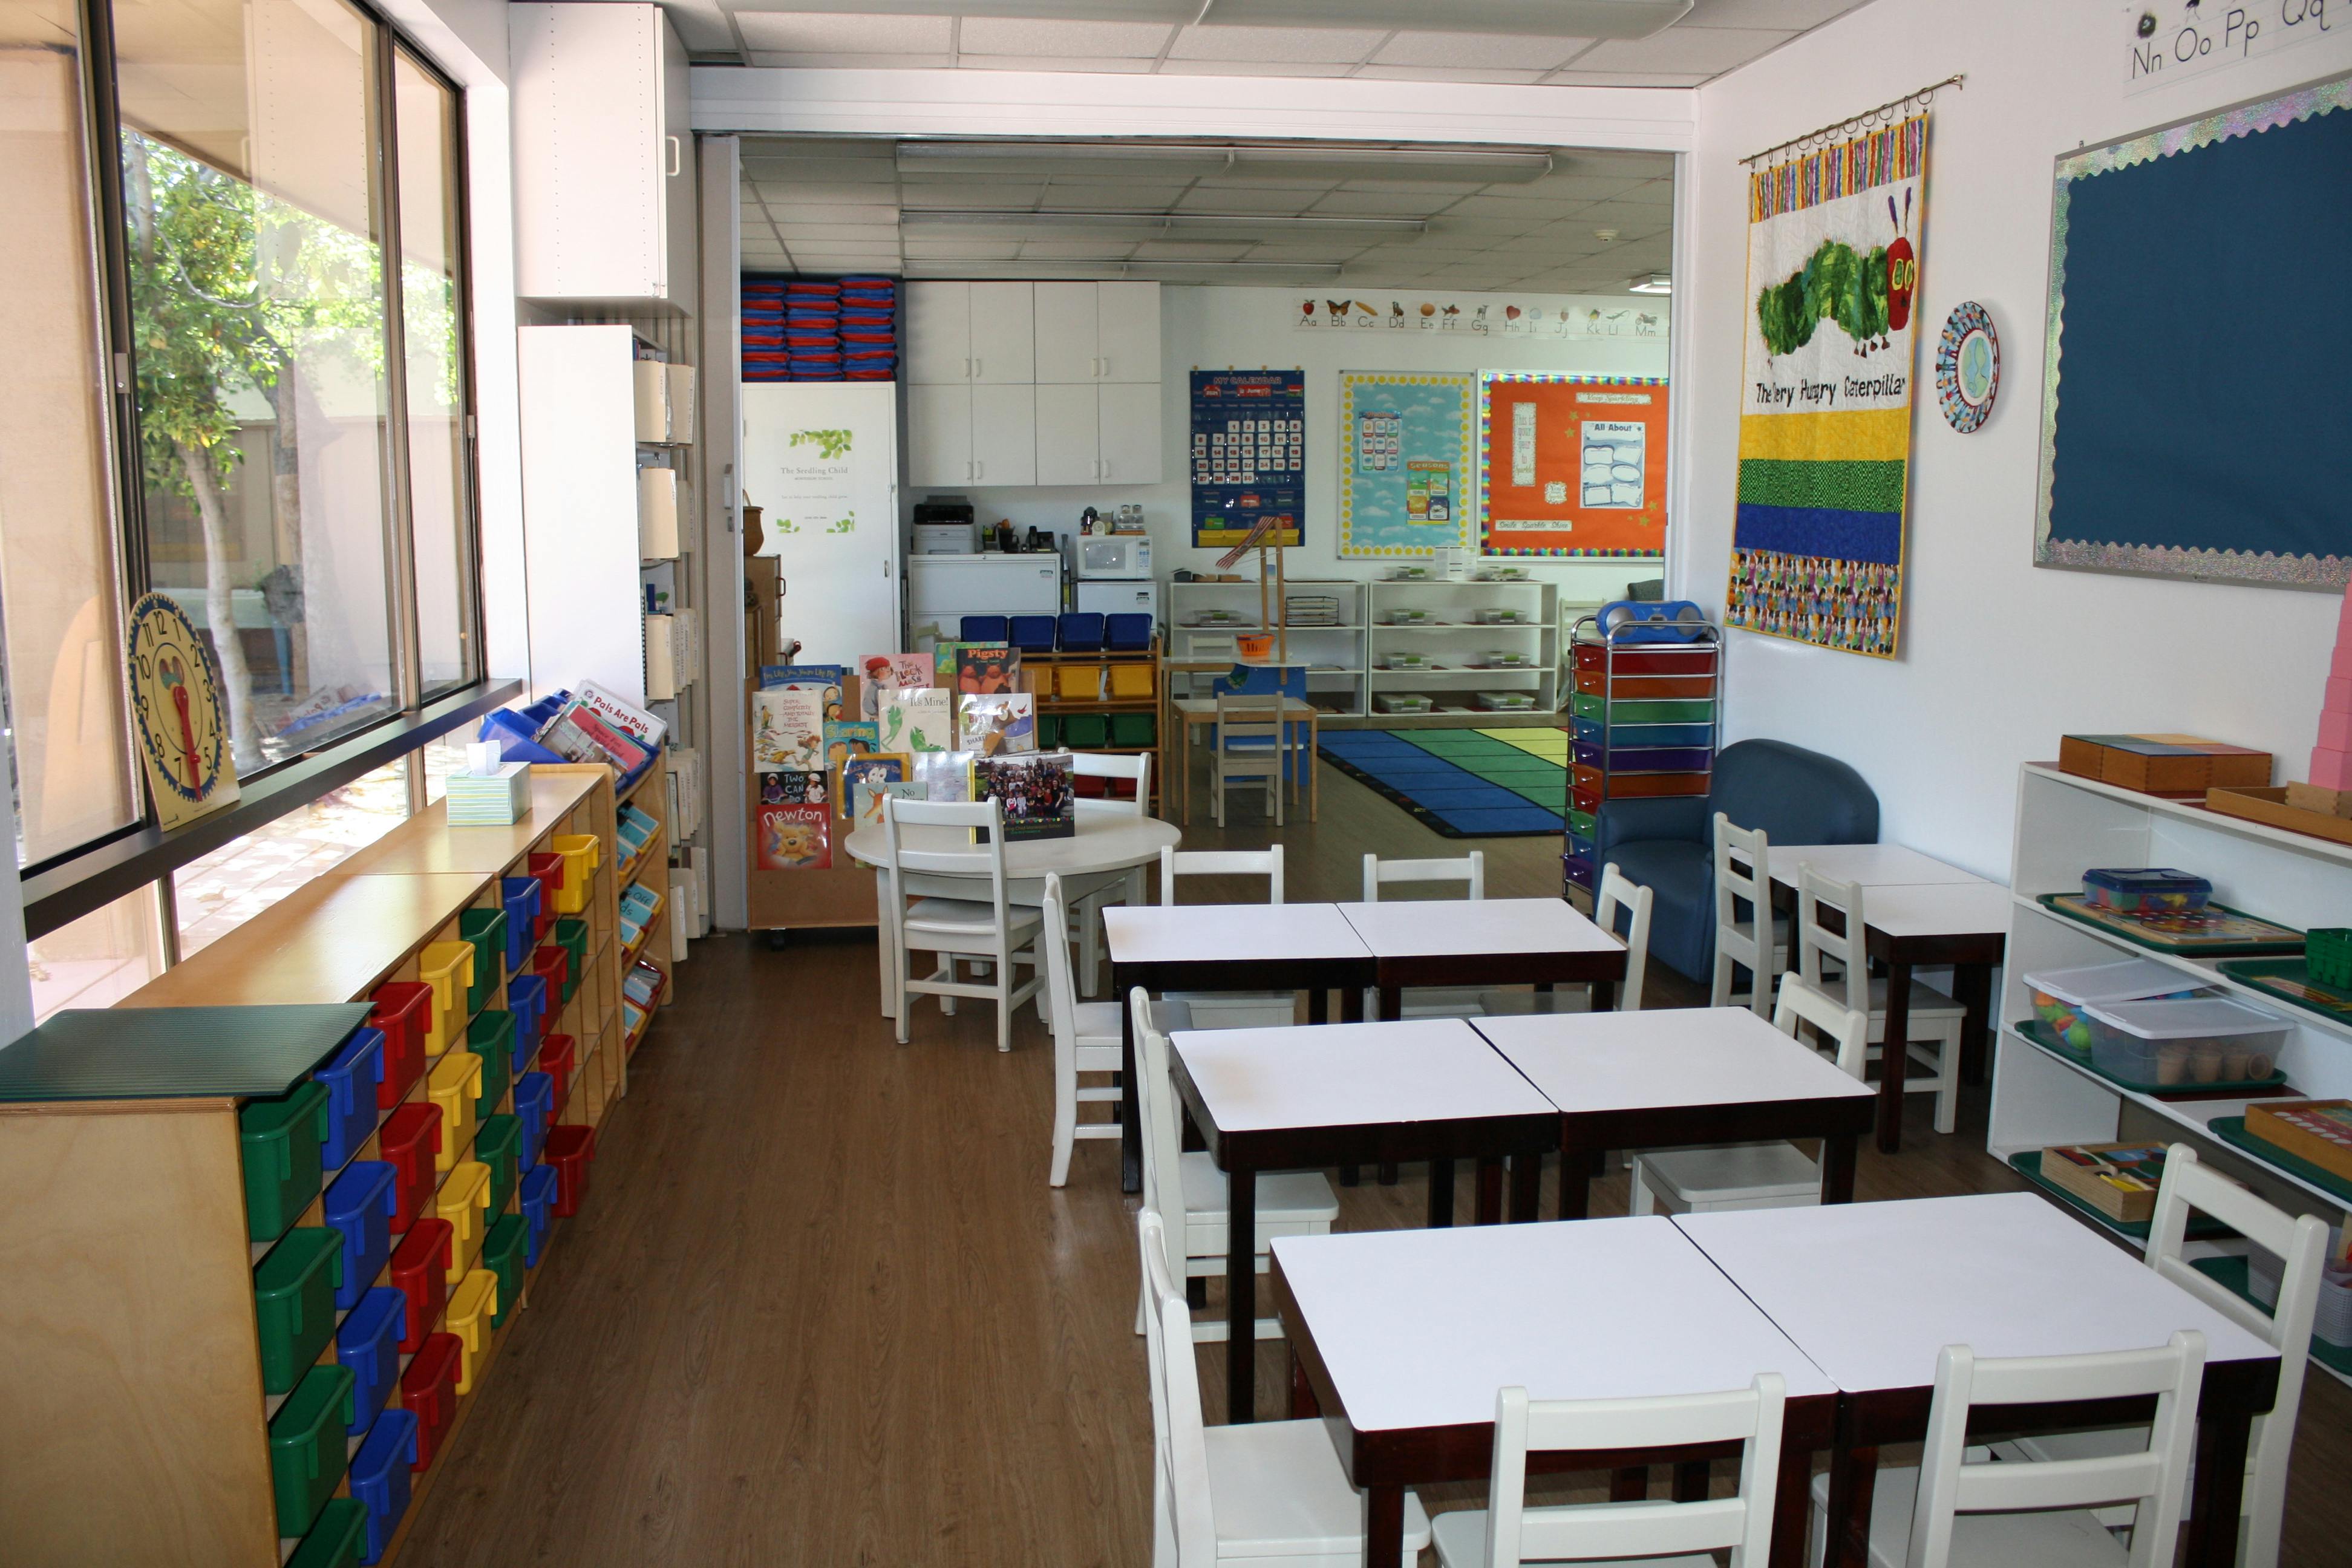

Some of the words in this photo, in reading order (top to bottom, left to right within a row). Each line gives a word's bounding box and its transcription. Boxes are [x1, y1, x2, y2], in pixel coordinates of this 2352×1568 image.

[2132, 42, 2161, 79] Nn
[2175, 28, 2211, 62] Oo
[2226, 9, 2259, 57] Pp
[1299, 315, 1316, 327] Aa
[1331, 316, 1346, 327] Bb
[1358, 316, 1374, 328] Cc
[1390, 317, 1404, 328] Dd
[1420, 318, 1434, 329] Ee
[1442, 319, 1457, 330] Ff
[1471, 320, 1488, 336] Gg
[1505, 321, 1520, 332] Hh
[1555, 322, 1567, 338] Jj
[1587, 324, 1600, 335] Kk
[1636, 326, 1656, 337] Mm
[1214, 376, 1229, 385] MY
[1230, 376, 1282, 385] CALENDAR
[1757, 382, 1772, 403] The
[1844, 373, 1906, 401] Caterpillar
[796, 467, 826, 475] Seedling
[142, 622, 154, 647] 11
[153, 610, 167, 635] 12
[172, 618, 181, 642] 1
[191, 644, 200, 668] 2
[968, 649, 1009, 660] Pigsty
[136, 653, 151, 681] 10
[203, 679, 212, 702] 3
[910, 697, 923, 707] It's
[924, 697, 949, 707] Mine!
[141, 694, 149, 721] 9
[594, 697, 612, 713] Pals
[614, 709, 629, 722] Are
[629, 717, 649, 733] Pals
[209, 717, 217, 737] 4
[155, 733, 165, 759] 8
[174, 756, 182, 785] 7
[203, 746, 212, 771] 5
[784, 774, 804, 783] TWO
[785, 785, 804, 793] CAN
[902, 788, 915, 799] No
[763, 807, 822, 827] newton
